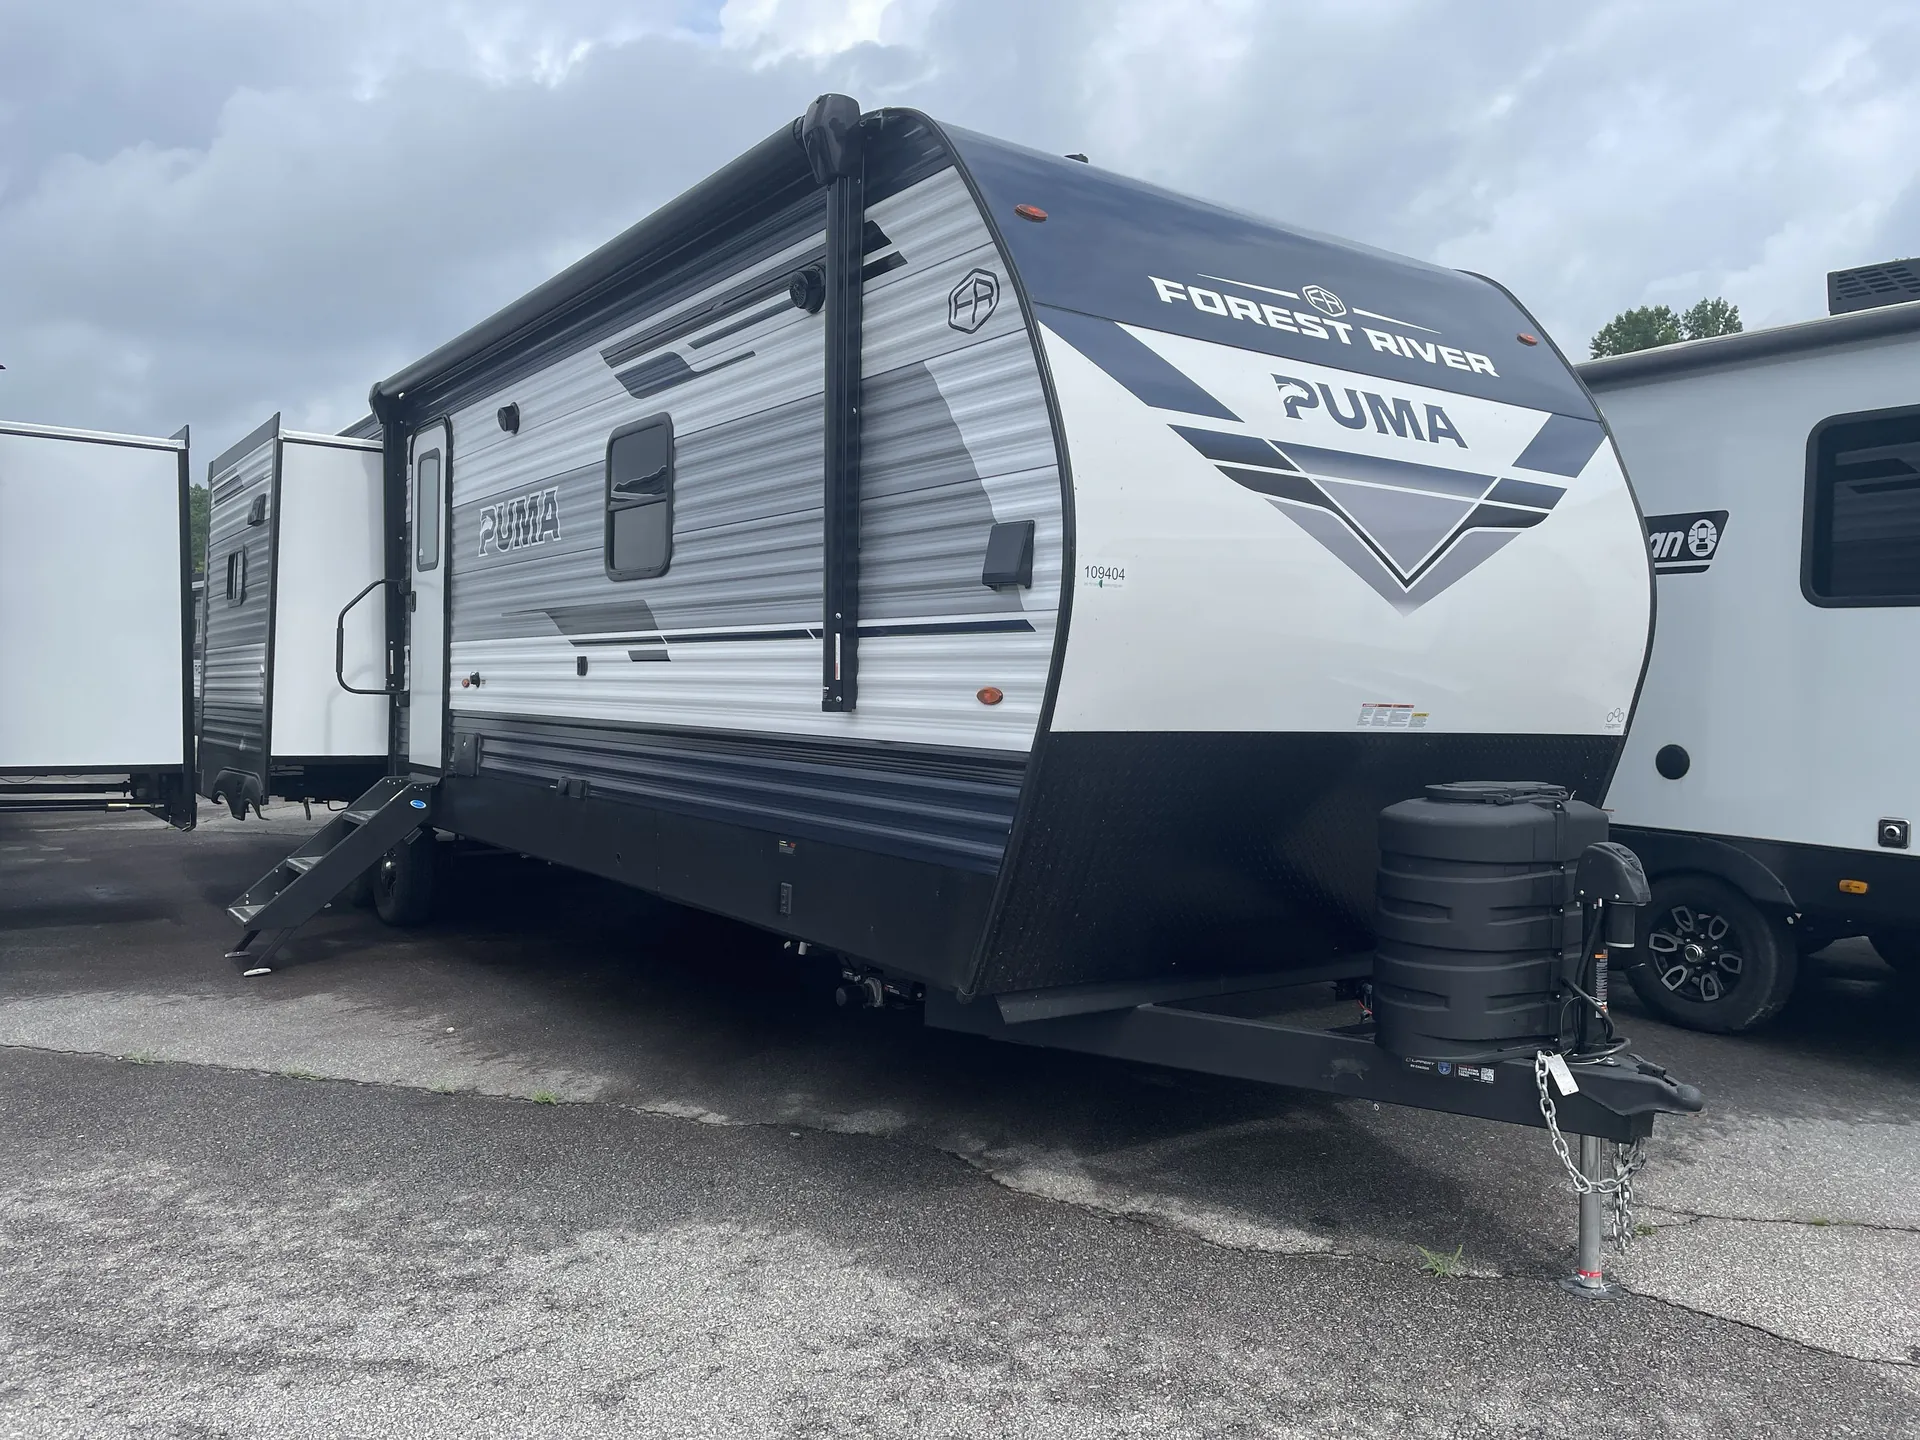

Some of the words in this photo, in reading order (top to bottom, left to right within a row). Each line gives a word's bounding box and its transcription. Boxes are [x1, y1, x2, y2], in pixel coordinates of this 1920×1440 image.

[1147, 275, 1354, 345] FOREST
[1361, 326, 1501, 378] RIVER
[1270, 372, 1470, 450] PUMA
[478, 486, 562, 557] PUMA
[1084, 565, 1126, 581] 109404
